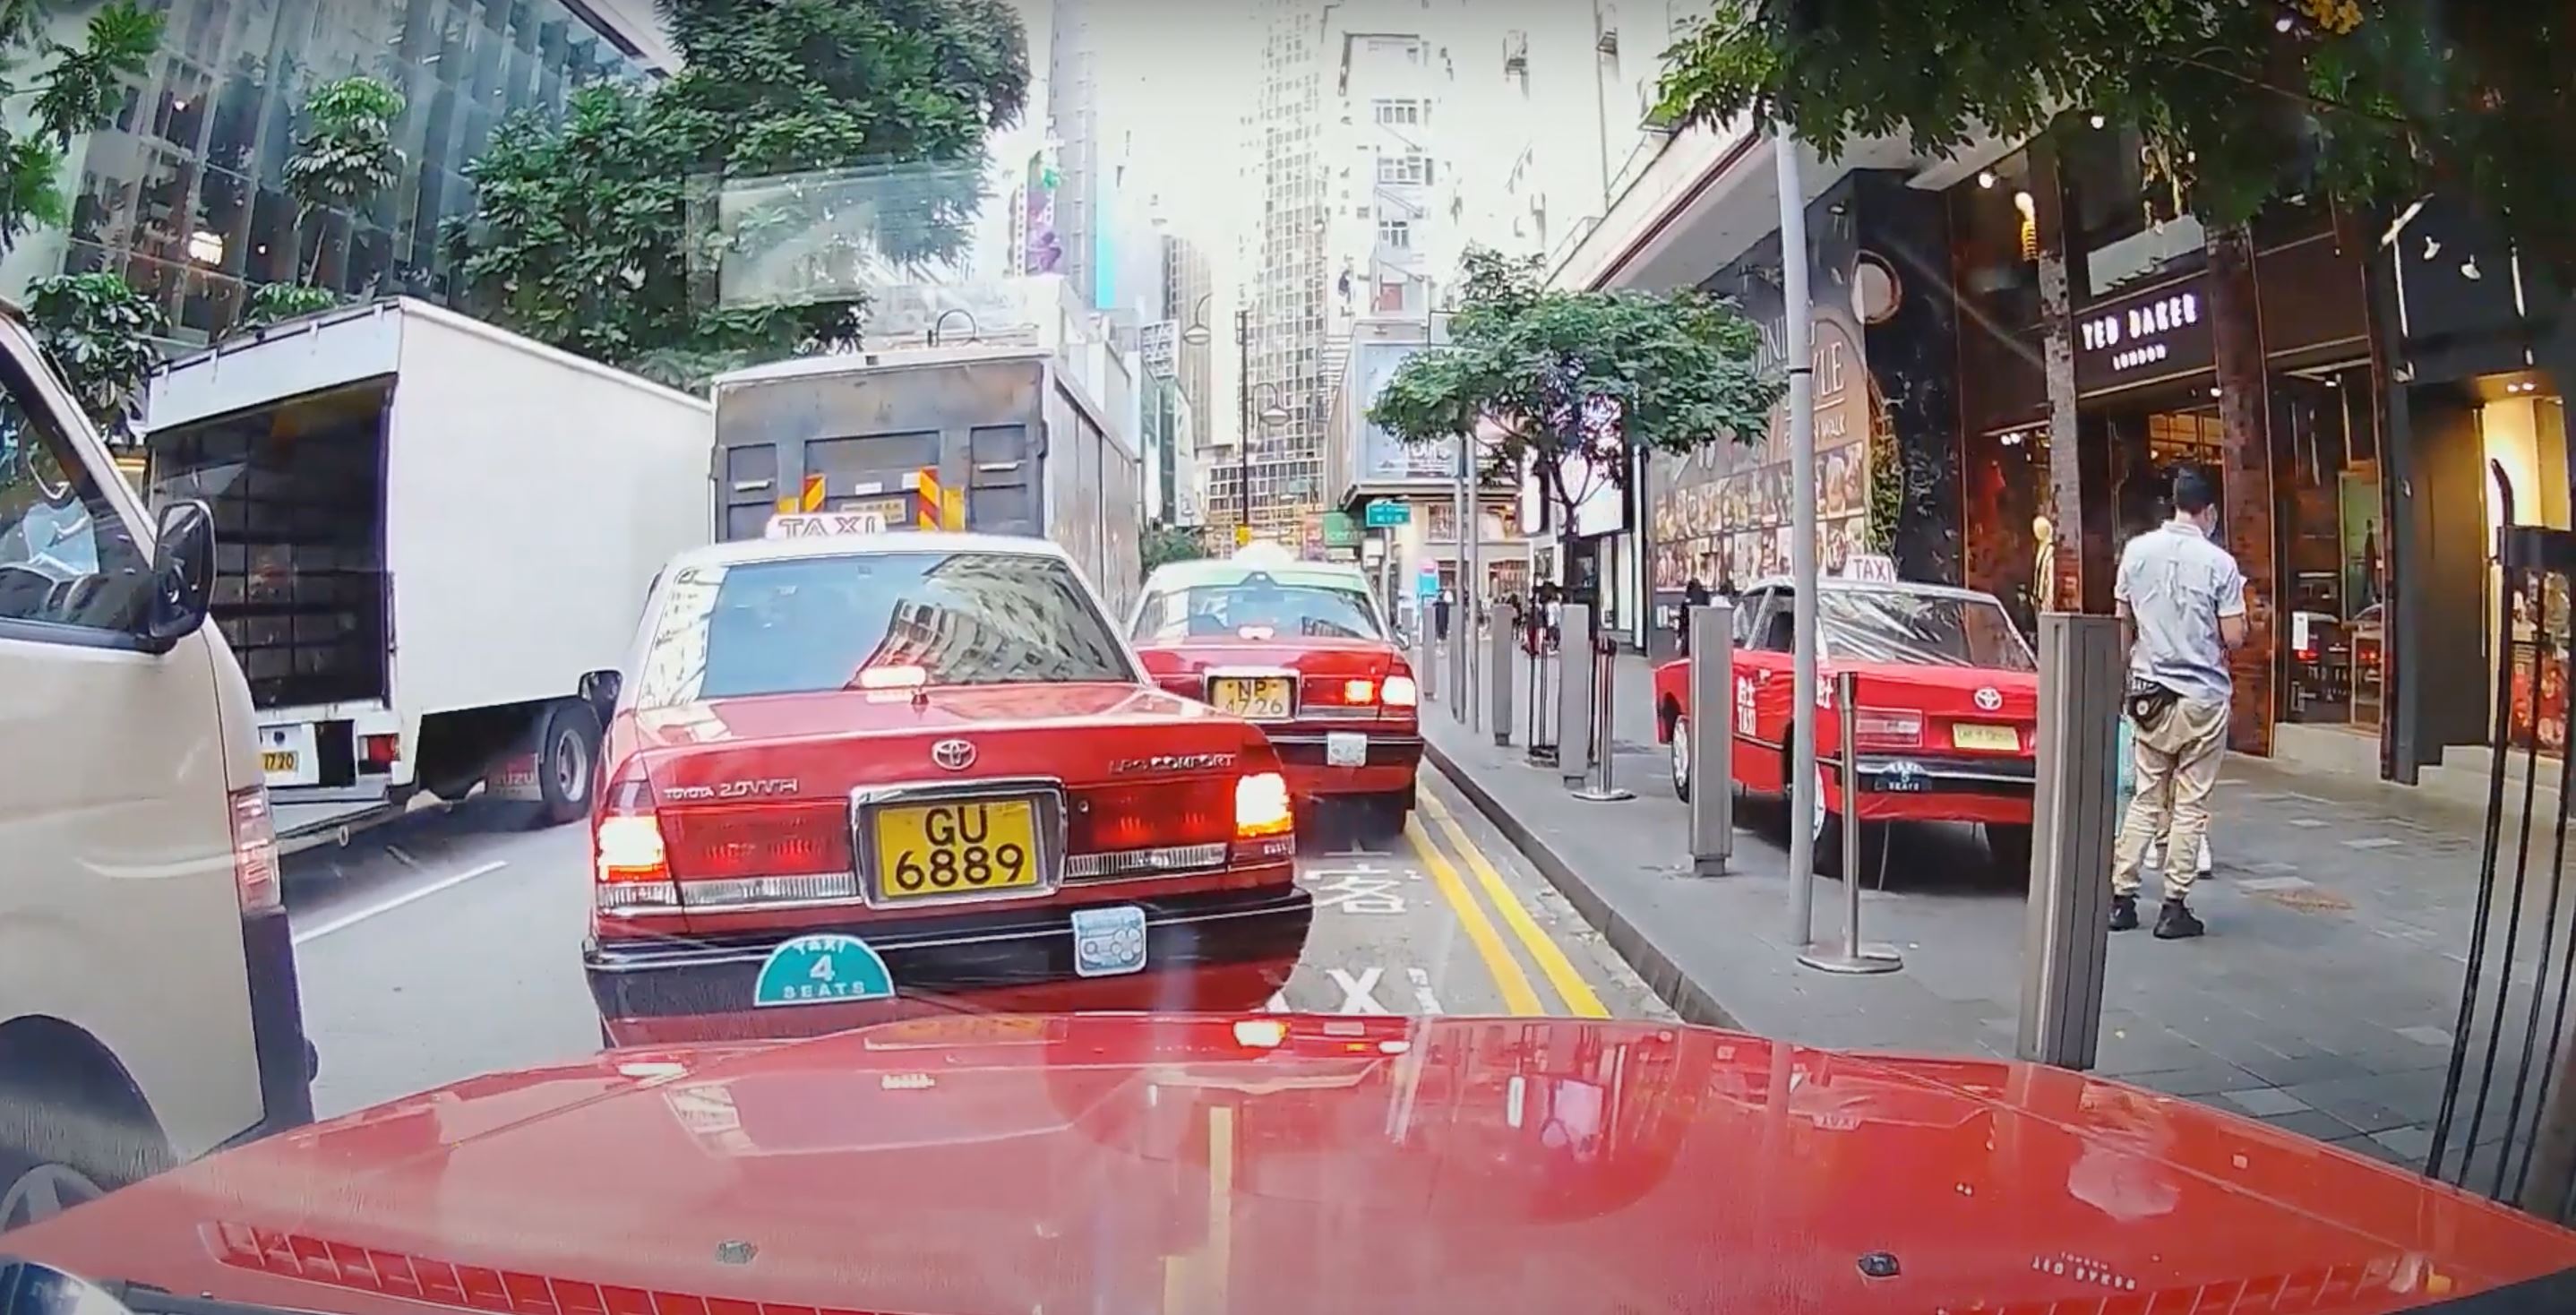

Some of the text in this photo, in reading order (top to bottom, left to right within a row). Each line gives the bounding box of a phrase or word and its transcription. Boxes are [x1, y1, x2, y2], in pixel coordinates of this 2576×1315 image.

[2082, 294, 2196, 350] TED BAKER
[2113, 344, 2166, 371] LONDON
[778, 516, 875, 537] TAXI
[1853, 558, 1892, 583] TAXI
[1238, 679, 1267, 701] NP
[1226, 698, 1284, 715] 4726
[664, 786, 715, 799] TOYOTA
[925, 805, 988, 847] GU
[896, 843, 1025, 890] 6889
[794, 941, 846, 955] TAXI
[810, 954, 835, 982] 4
[784, 981, 865, 999] SEATS
